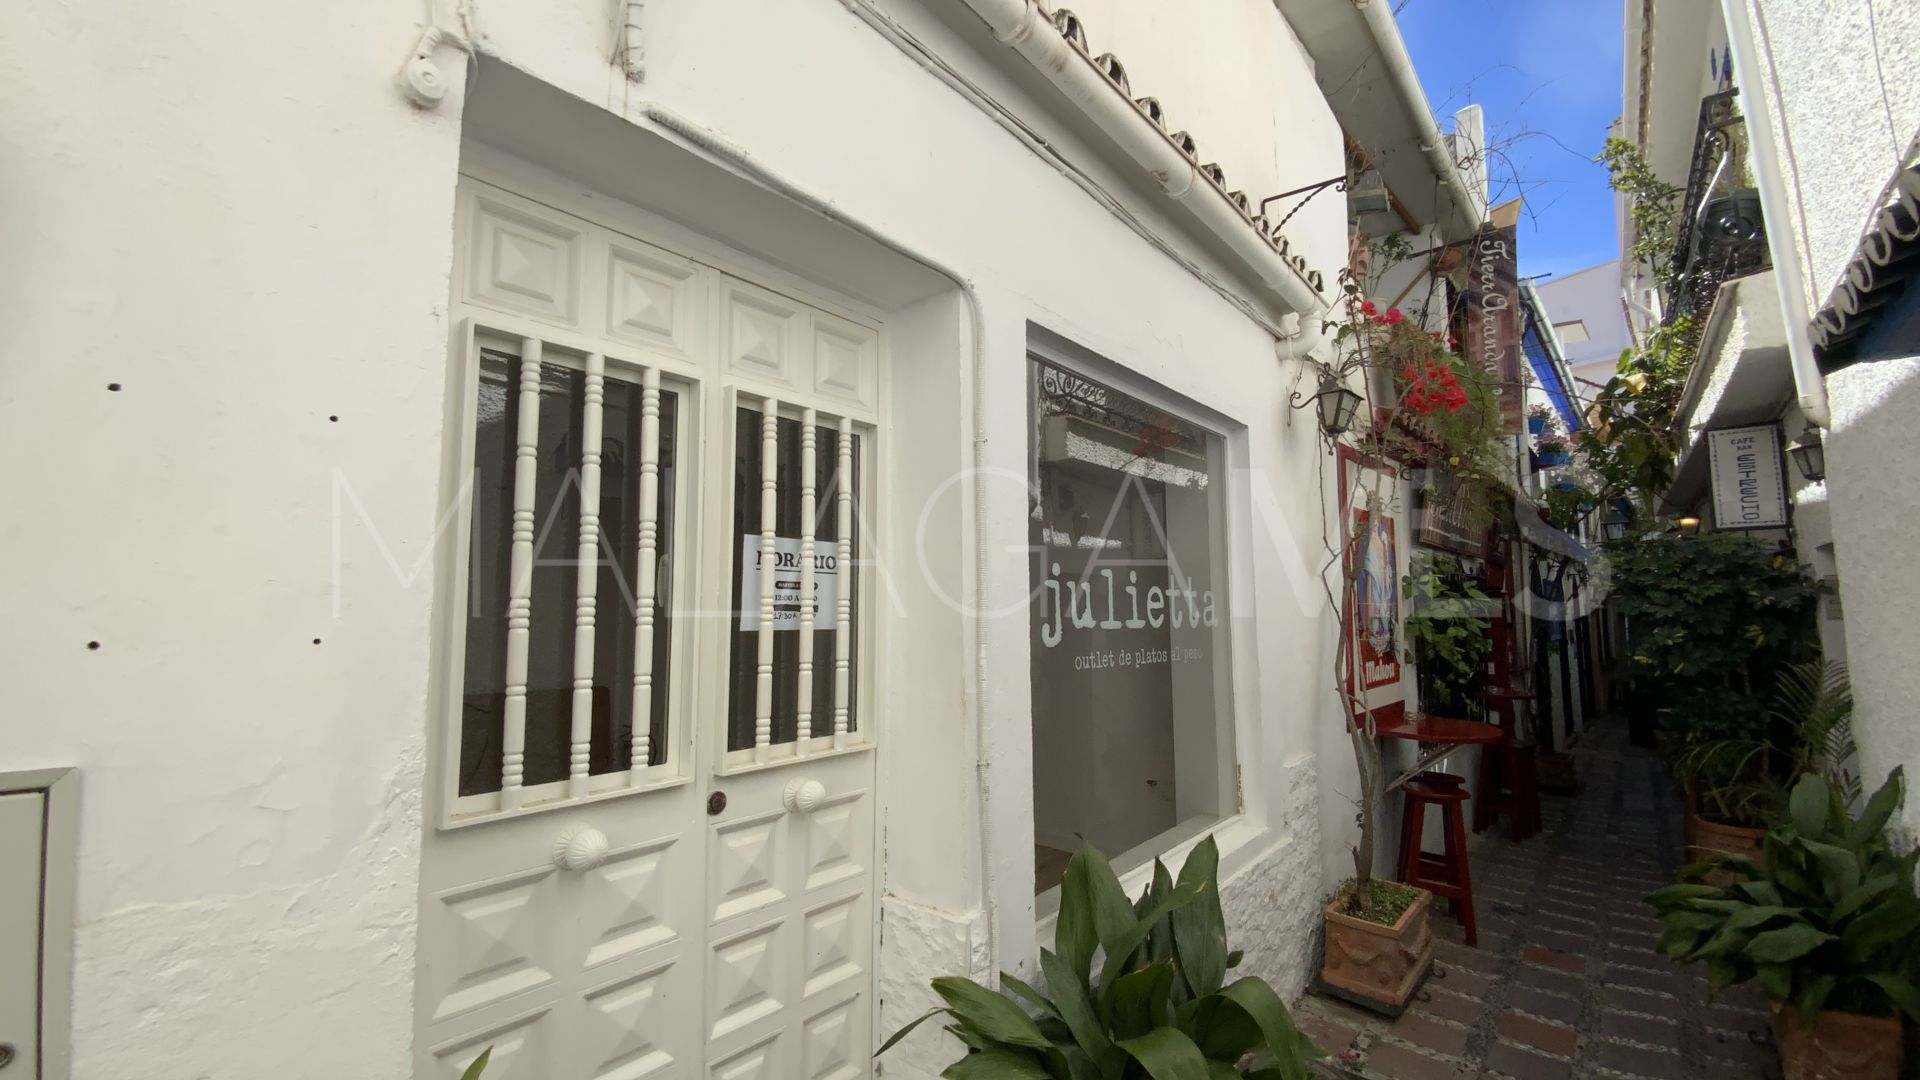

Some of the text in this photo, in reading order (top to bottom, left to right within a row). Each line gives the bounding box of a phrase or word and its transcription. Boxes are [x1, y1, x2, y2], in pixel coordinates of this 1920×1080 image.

[1736, 453, 1760, 521] ESTRECHO
[756, 550, 837, 570] ORARIO
[775, 594, 793, 602] 12:00
[1041, 562, 1219, 648] julietta
[1075, 651, 1115, 670] outlet
[1118, 649, 1132, 666] de
[1135, 648, 1168, 668] platos
[1171, 646, 1181, 661] al
[1365, 658, 1395, 684] Mahou
